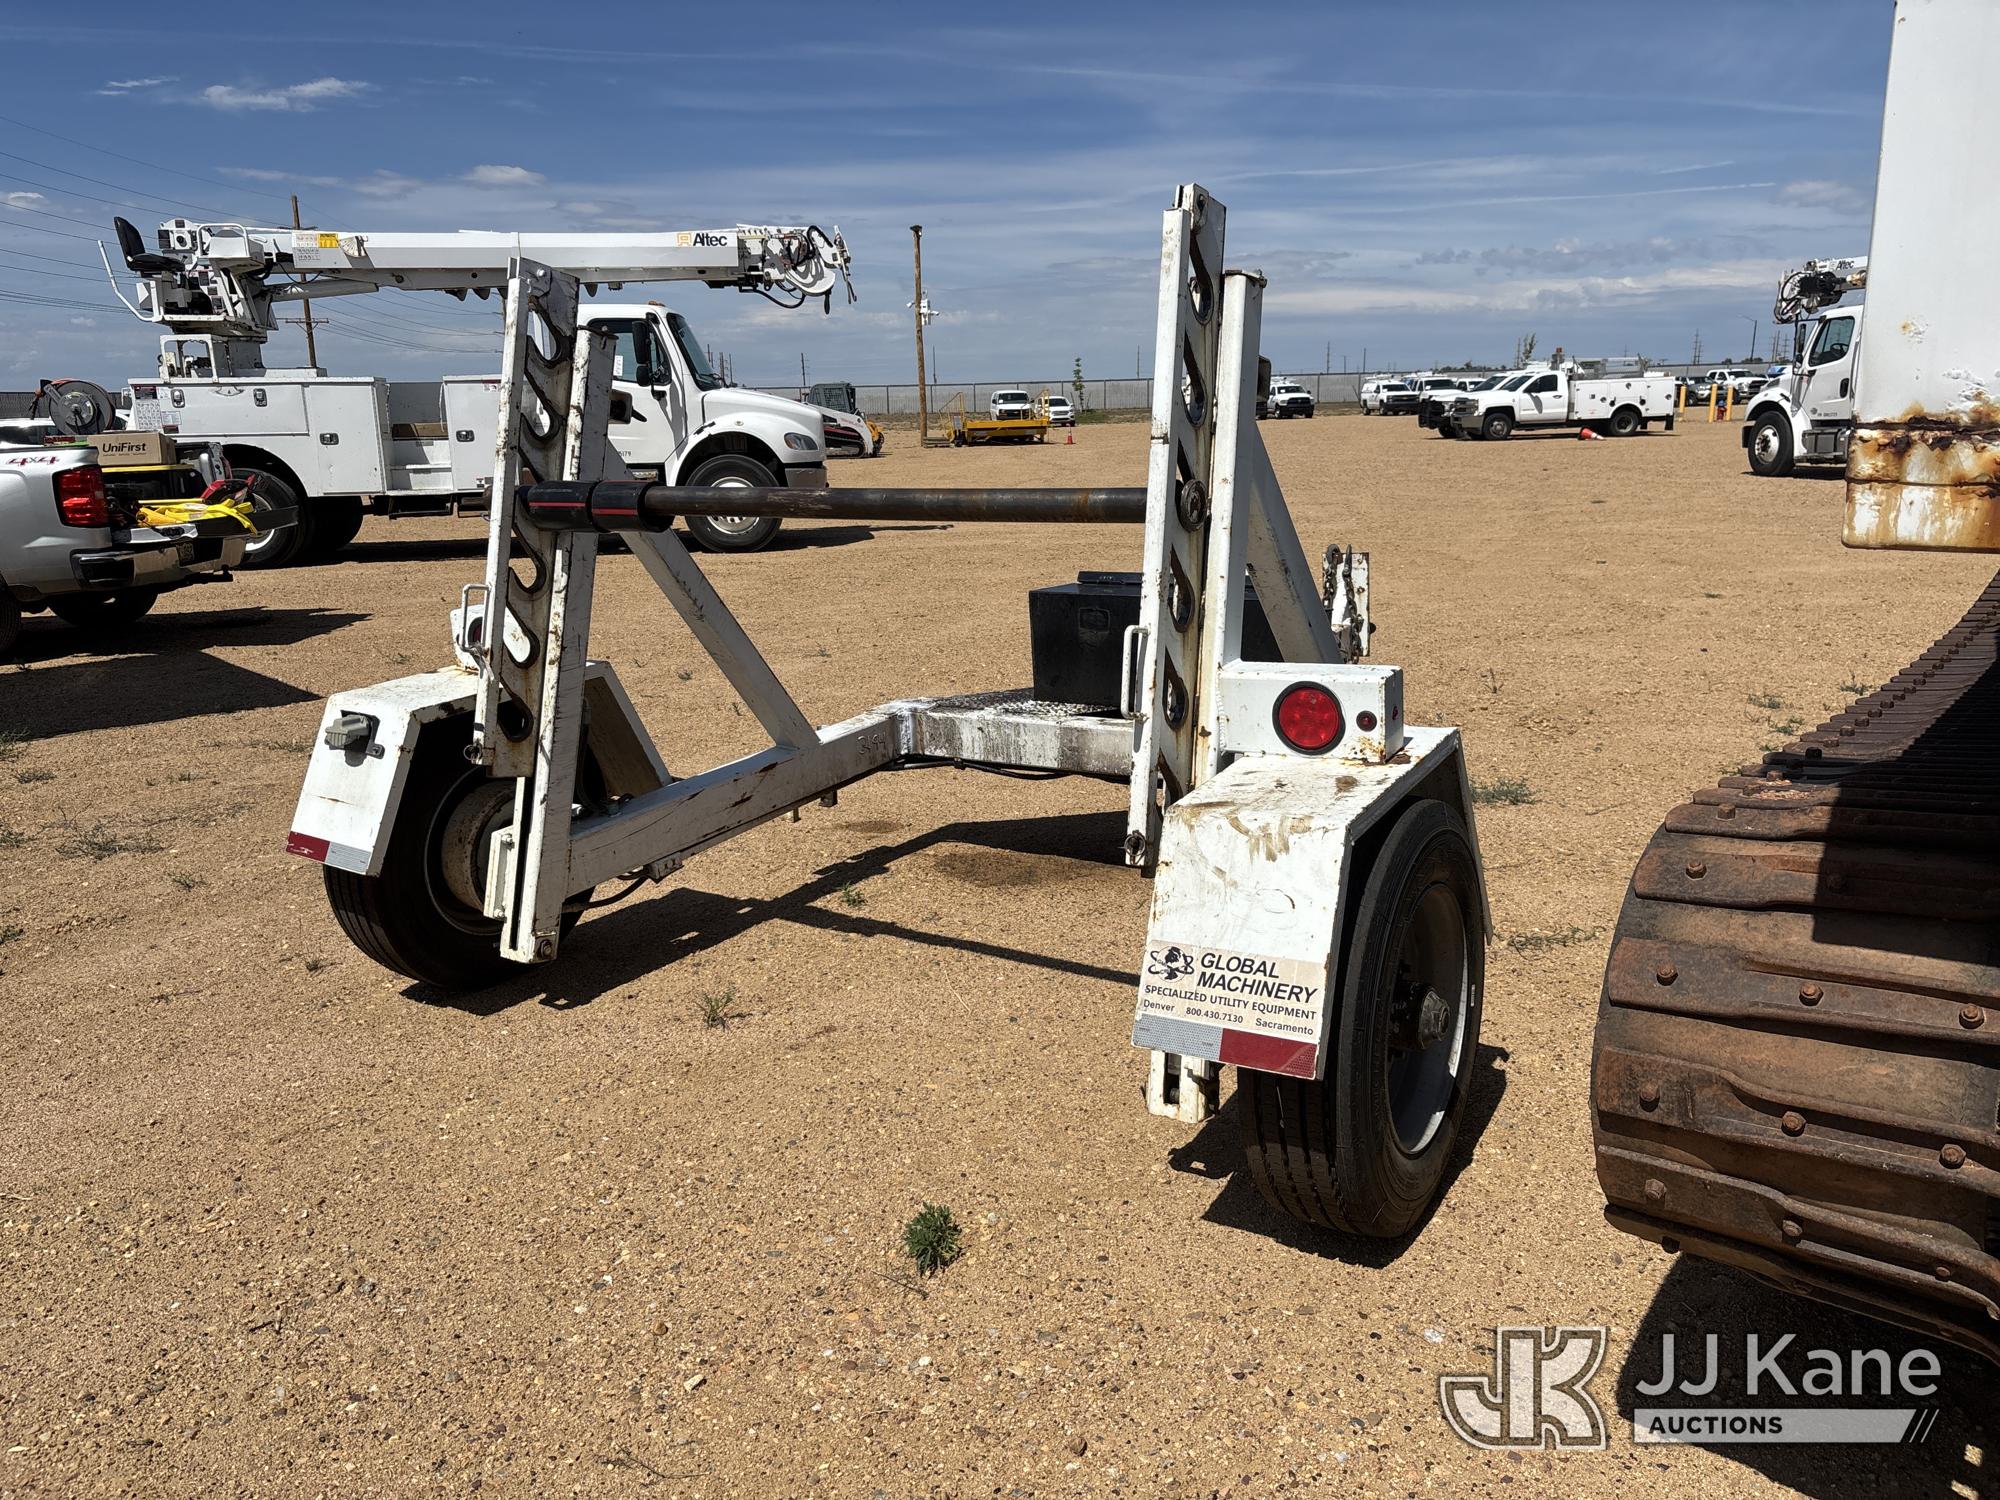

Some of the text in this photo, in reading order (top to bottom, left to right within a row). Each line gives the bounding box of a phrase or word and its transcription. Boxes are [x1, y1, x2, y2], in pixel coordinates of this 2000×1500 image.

[693, 232, 728, 246] Altec
[102, 442, 146, 453] UniFirst
[1200, 952, 1280, 979] GLOBAL
[1144, 984, 1317, 1020] SPECIALIZED UTILITY EQUIPMENT
[1197, 971, 1318, 1004] MACHINERY
[1143, 999, 1314, 1036] Denver 800.430.7130 Sacramento
